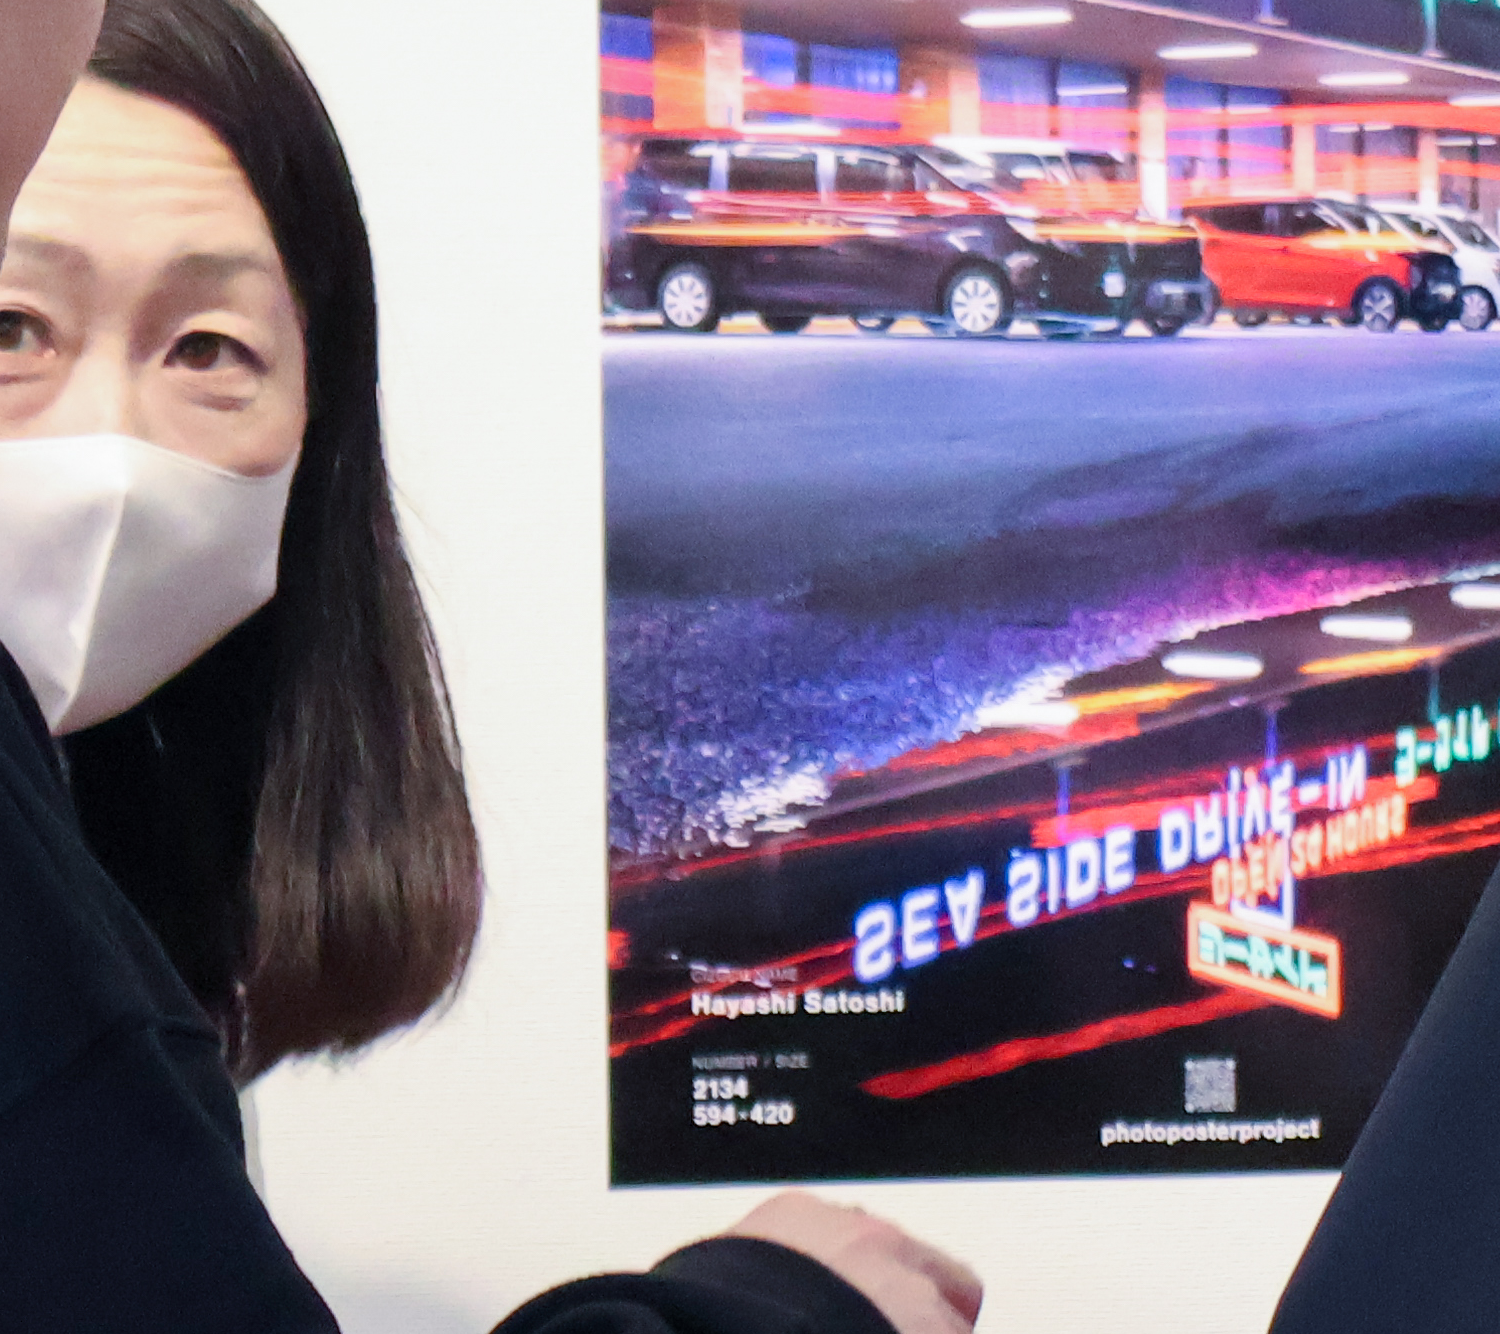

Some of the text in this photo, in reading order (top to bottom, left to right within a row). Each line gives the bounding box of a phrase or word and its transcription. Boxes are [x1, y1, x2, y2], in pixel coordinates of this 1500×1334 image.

[691, 989, 906, 1020] Hayashi Satoshi
[692, 1076, 749, 1101] 2134
[1100, 1118, 1322, 1148] photoposterproject
